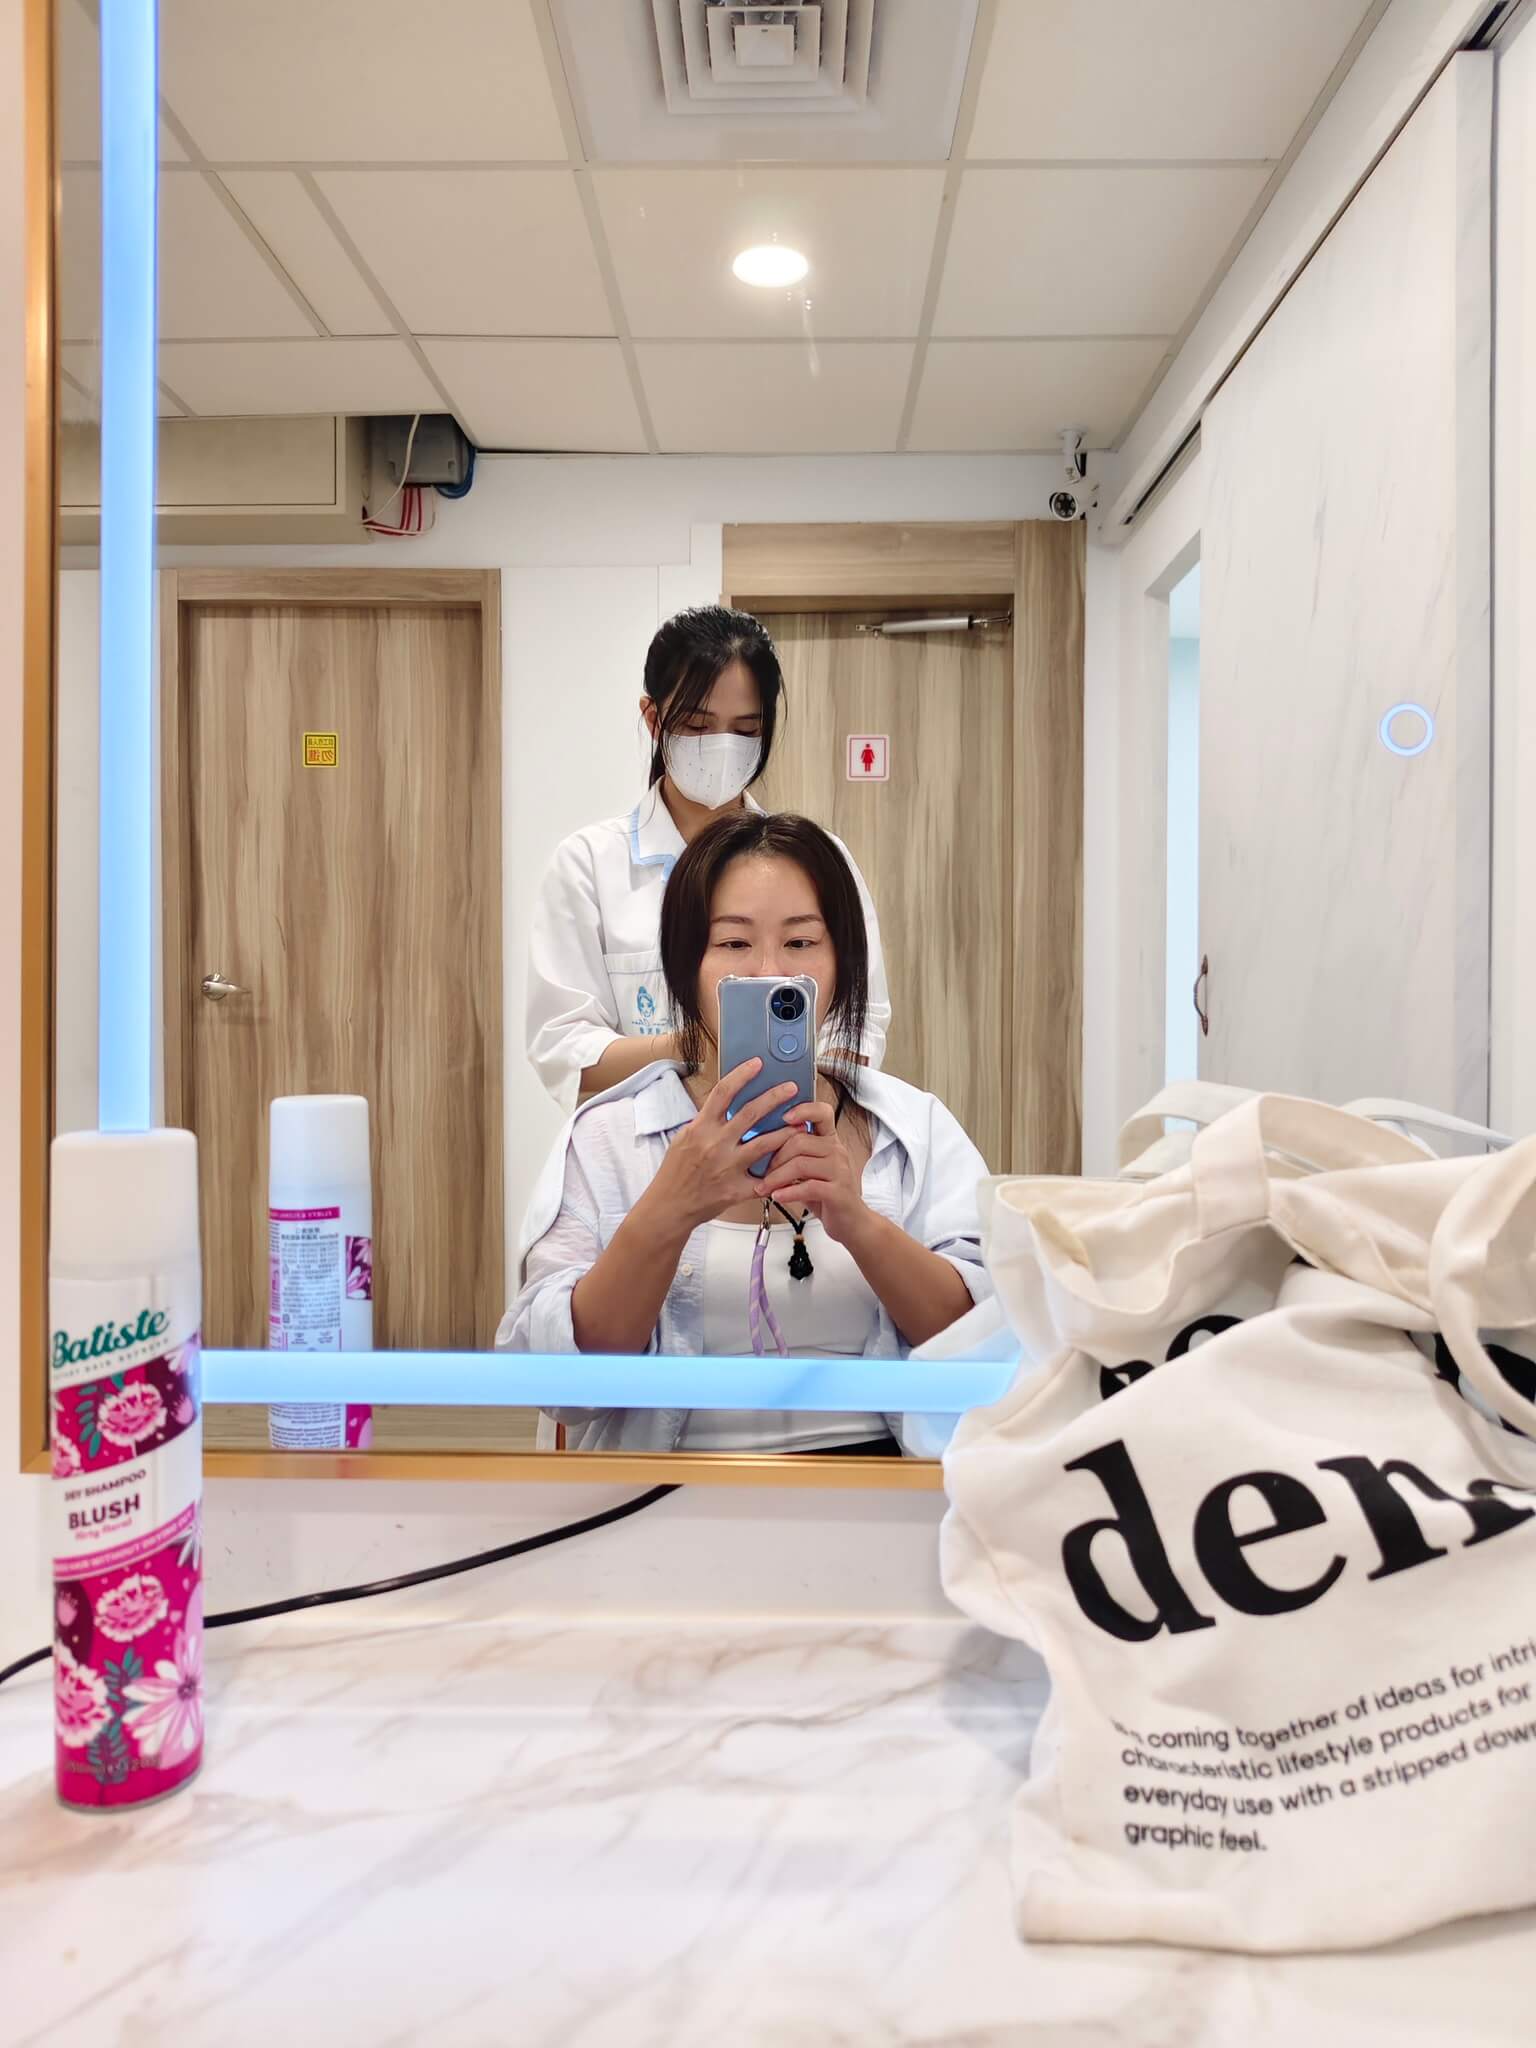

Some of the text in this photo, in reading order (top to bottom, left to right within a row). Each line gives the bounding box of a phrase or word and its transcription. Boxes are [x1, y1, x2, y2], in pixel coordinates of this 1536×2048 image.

[52, 1309, 169, 1368] Batiste
[68, 1493, 140, 1530] BLUSH
[85, 1469, 146, 1497] SHAMPOO
[1121, 1683, 1531, 1780] characteristic lifestyle products for
[1147, 1726, 1229, 1751] coming
[1237, 1708, 1338, 1750] together
[1345, 1694, 1369, 1721] of
[1375, 1677, 1447, 1712] ideas
[1450, 1663, 1483, 1688] for
[1123, 1785, 1228, 1817] everyday
[1233, 1797, 1273, 1816] use
[1279, 1781, 1333, 1813] with
[1339, 1779, 1358, 1798] a
[1362, 1740, 1469, 1791] stripped
[1124, 1822, 1268, 1852] graphic feel.
